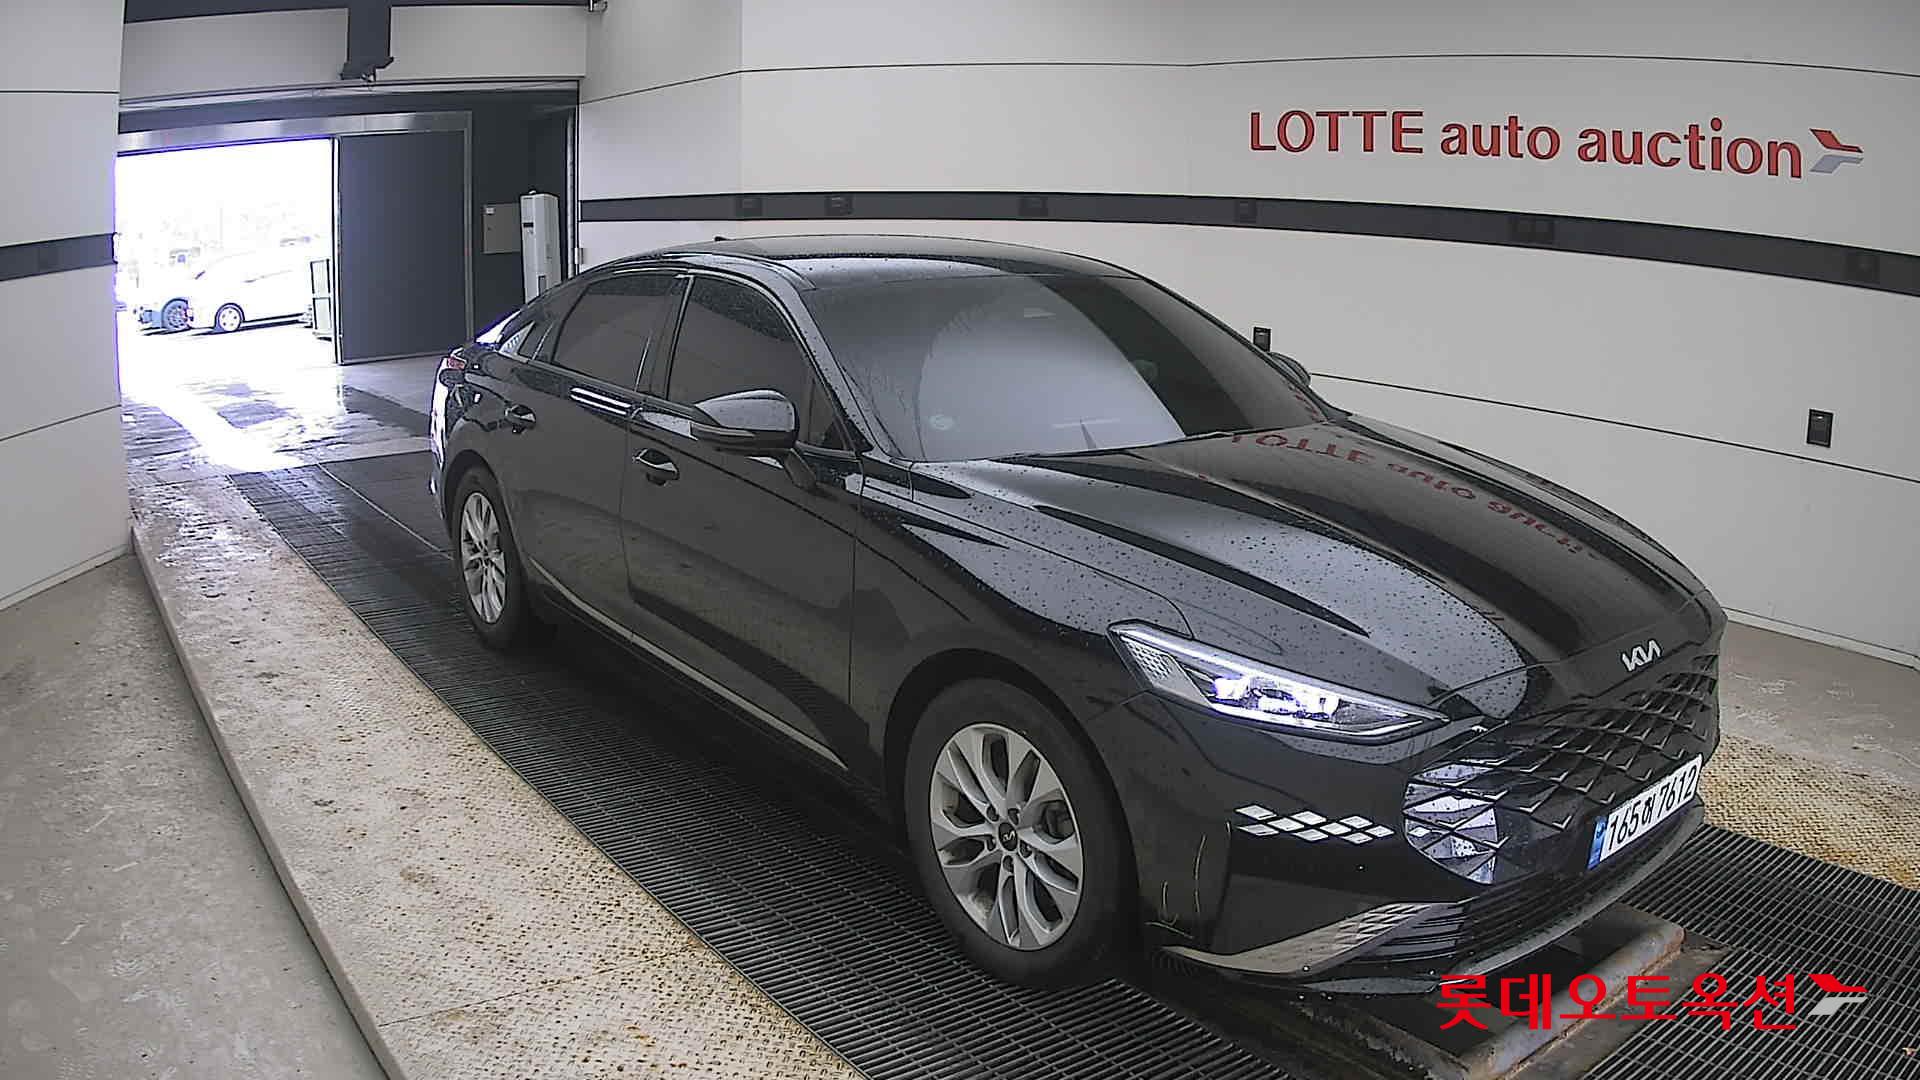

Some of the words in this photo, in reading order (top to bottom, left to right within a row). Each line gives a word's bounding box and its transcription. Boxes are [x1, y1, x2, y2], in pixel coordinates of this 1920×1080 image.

[1250, 110, 1424, 154] LOTTE
[1441, 115, 1562, 159] auto
[1577, 117, 1803, 178] auction
[1621, 639, 1661, 671] KIA
